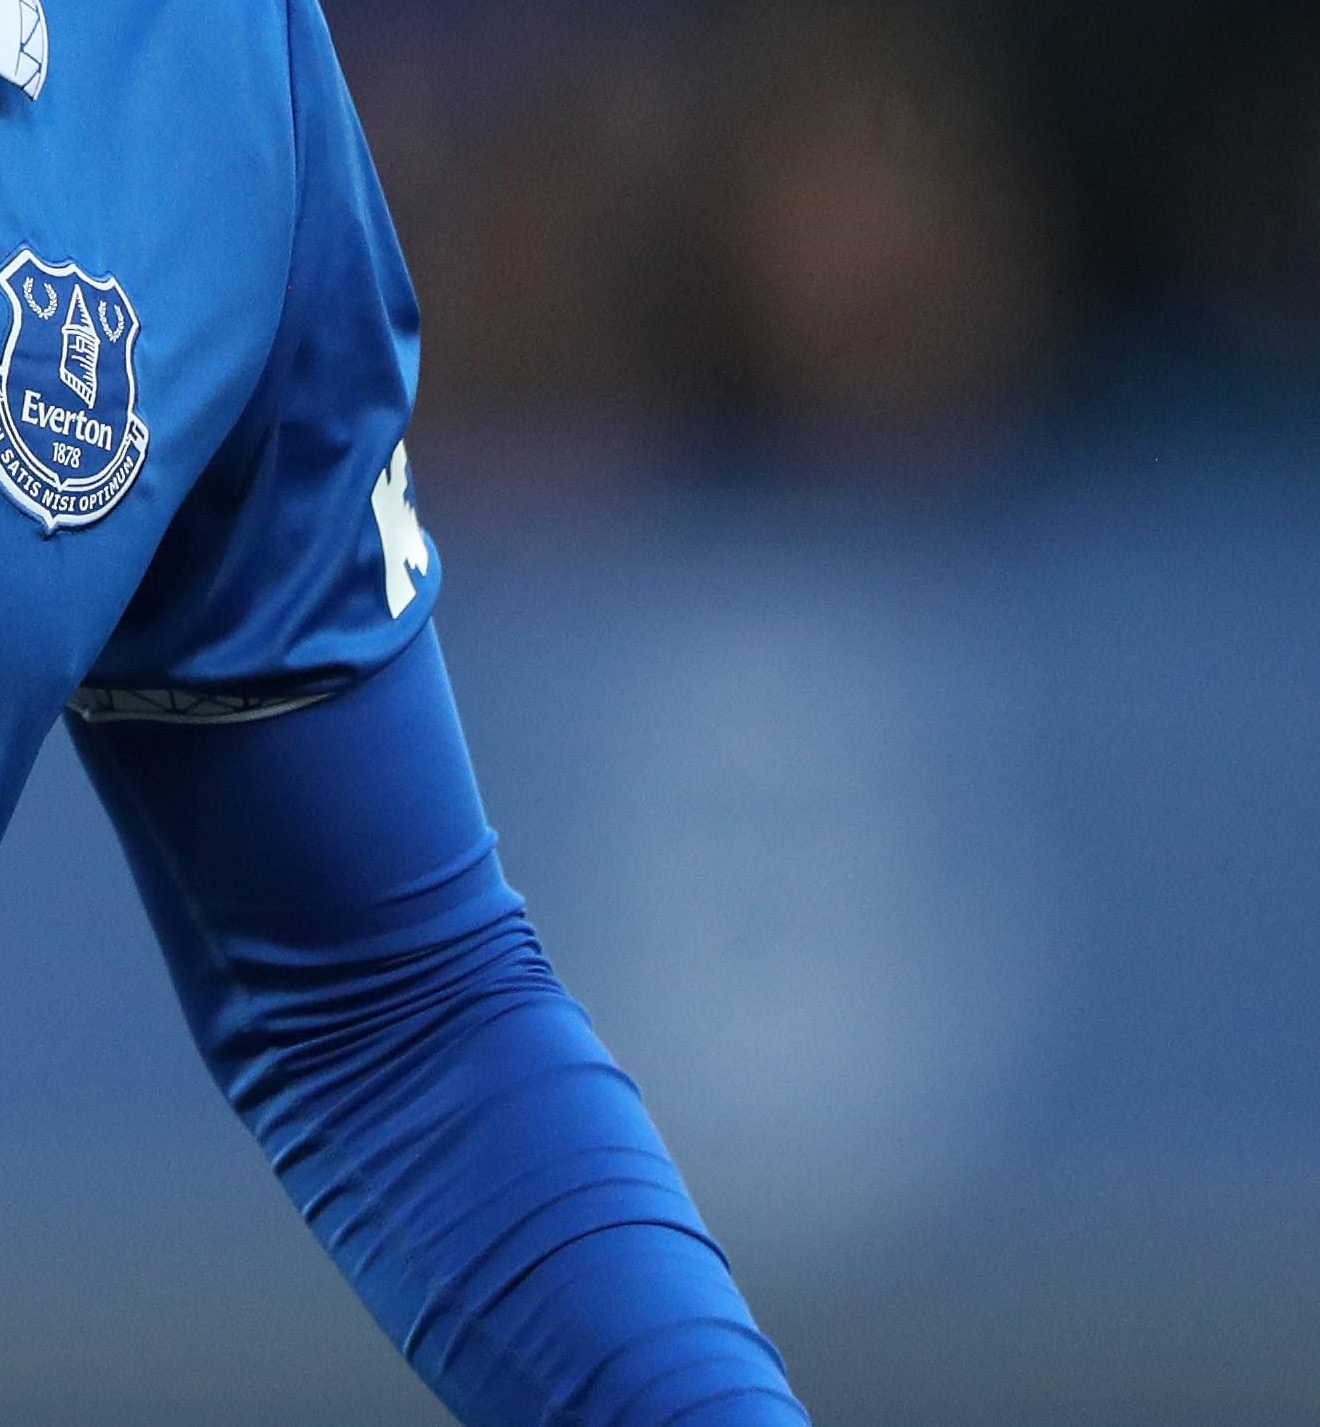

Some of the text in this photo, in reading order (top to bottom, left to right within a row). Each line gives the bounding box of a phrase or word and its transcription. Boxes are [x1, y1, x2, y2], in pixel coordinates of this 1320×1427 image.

[21, 390, 113, 451] Everton
[0, 451, 42, 498] SATIS
[41, 490, 76, 512] NISI
[78, 455, 135, 513] OPTIMUM
[51, 442, 81, 469] 1878
